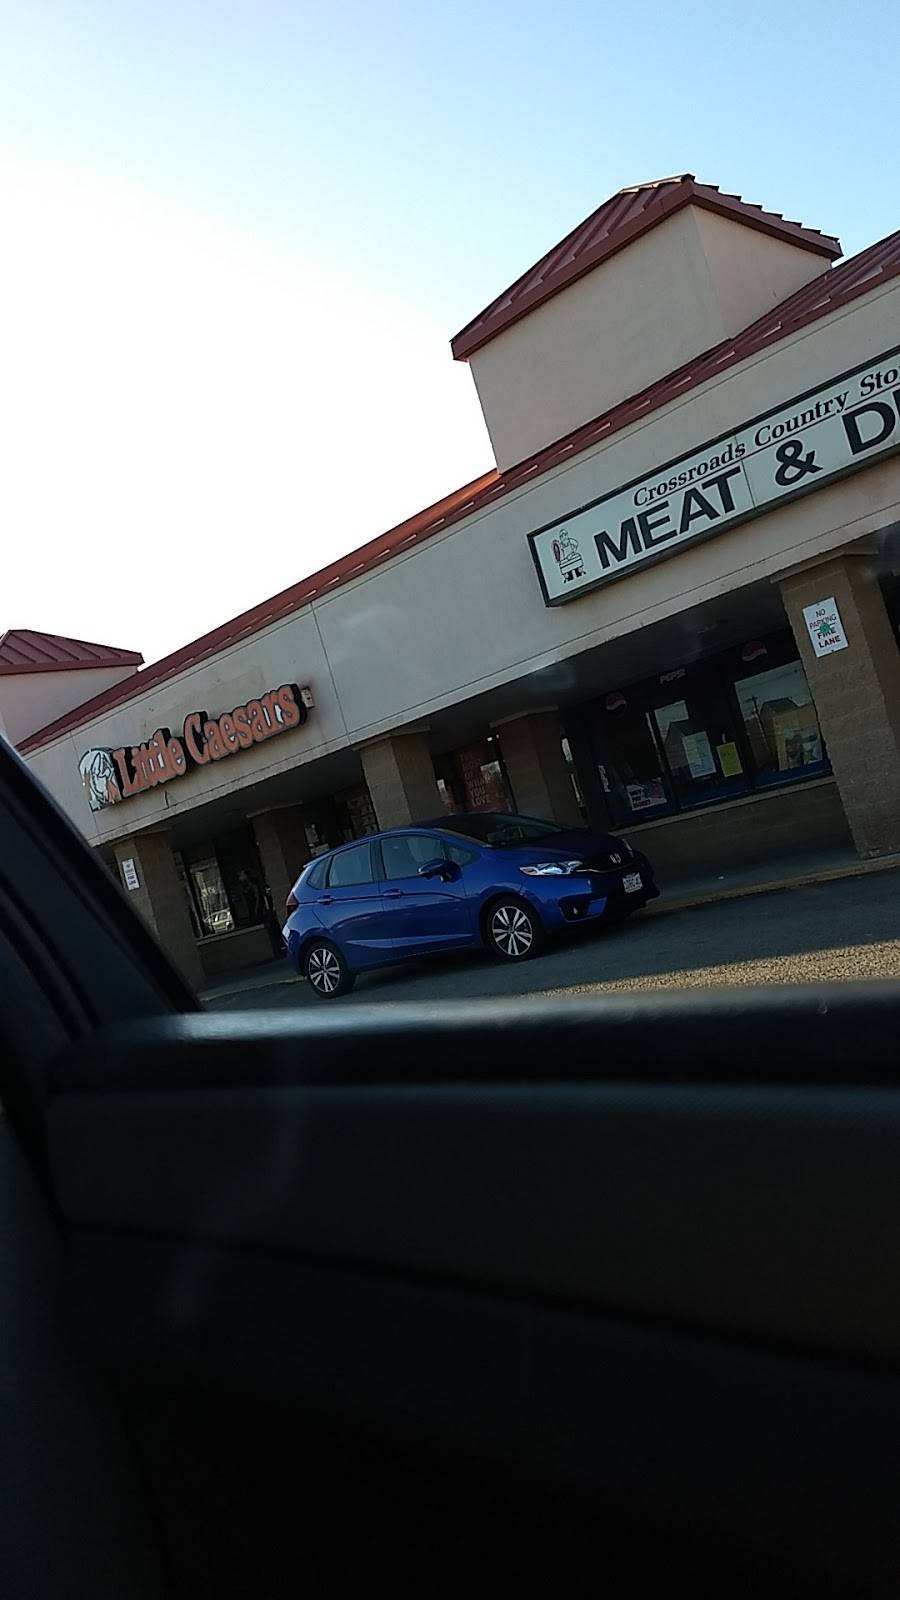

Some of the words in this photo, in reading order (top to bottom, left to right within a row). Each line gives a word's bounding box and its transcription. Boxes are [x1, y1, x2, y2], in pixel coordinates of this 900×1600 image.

[633, 442, 746, 508] Crossroads
[754, 391, 849, 447] Country
[860, 366, 900, 397] Sto
[593, 466, 742, 570] MEAT
[774, 440, 824, 487] &
[842, 389, 900, 456] D
[809, 614, 837, 630] PARKING
[815, 608, 826, 618] NO
[818, 635, 841, 649] LANE
[113, 728, 188, 798] Little
[184, 684, 307, 766] Caesars
